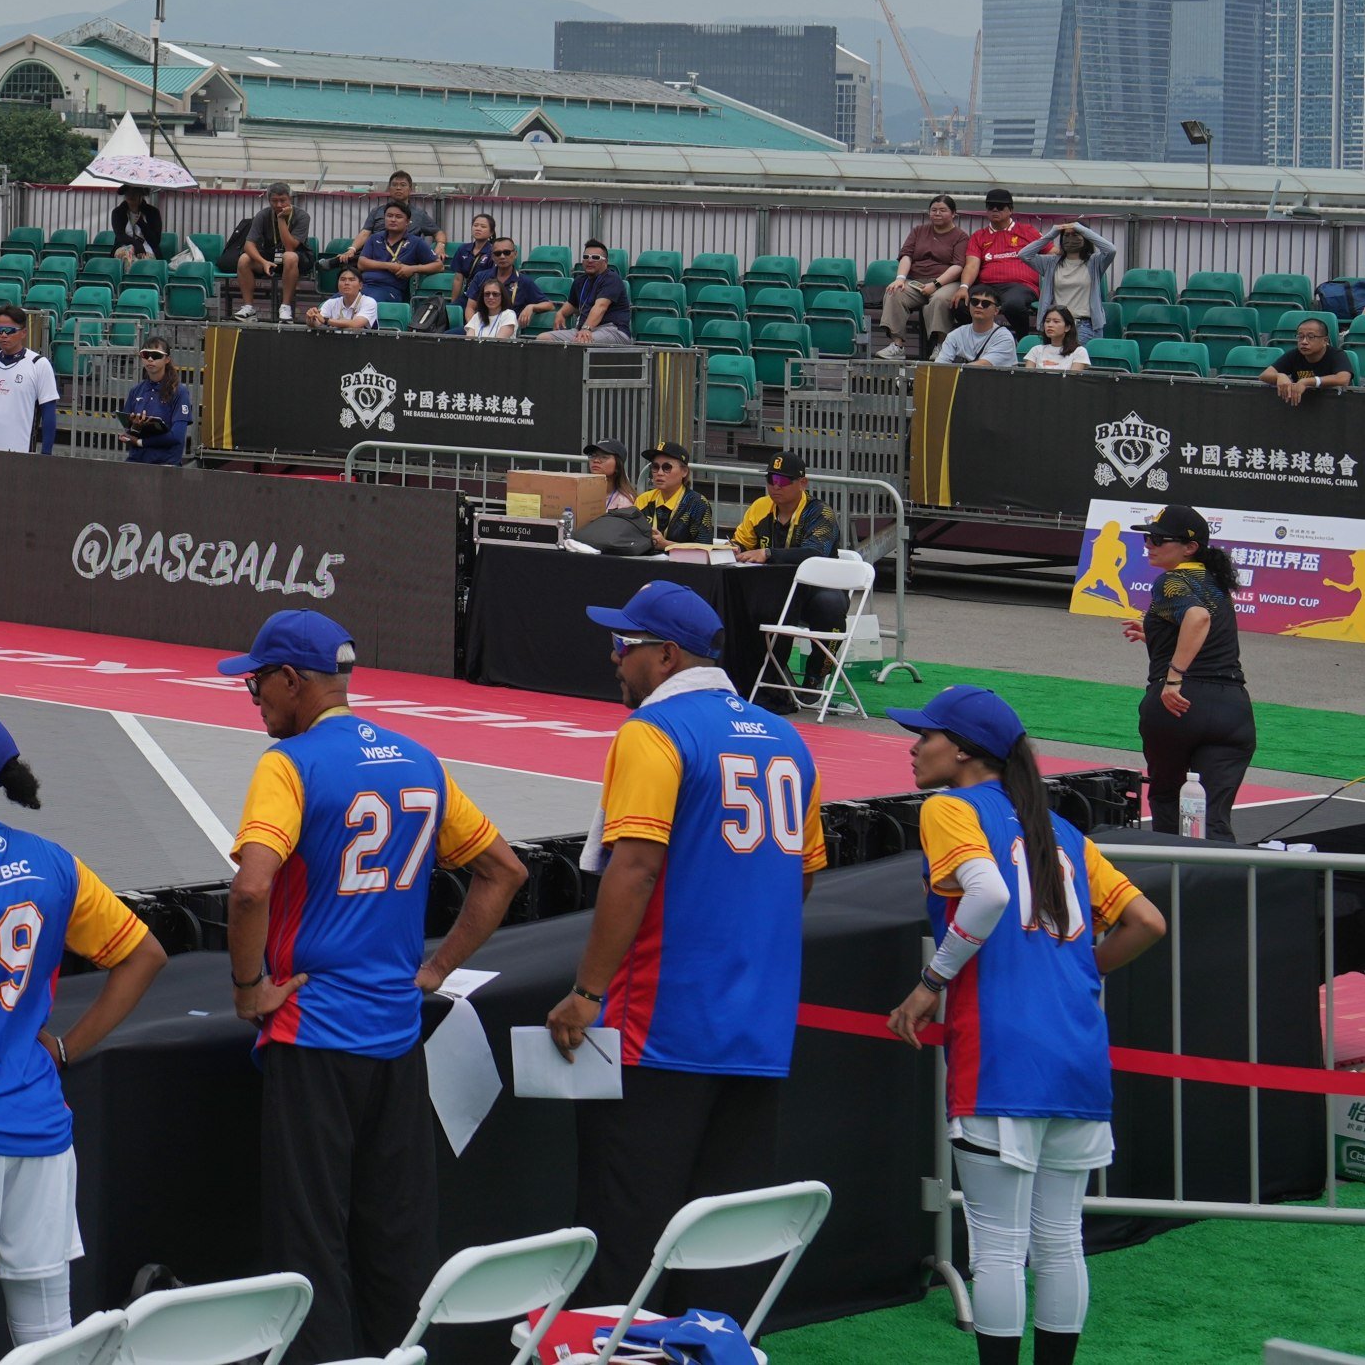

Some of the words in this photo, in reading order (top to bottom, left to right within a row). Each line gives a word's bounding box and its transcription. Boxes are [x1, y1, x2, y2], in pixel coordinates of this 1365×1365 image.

[340, 371, 397, 394] BAHKC
[403, 388, 535, 416] 中國香港棒球總會
[402, 409, 413, 417] THE
[413, 410, 439, 419] BASEBALL
[439, 412, 475, 421] ASSOCIATION
[475, 414, 482, 422] OF
[482, 415, 499, 423] HONG
[517, 417, 535, 425] CHINA
[1095, 421, 1171, 447] BAHKC
[1179, 441, 1359, 477] 中國香港棒球總會
[1179, 466, 1193, 475] THE
[1193, 467, 1229, 478] BASEBALL
[1229, 469, 1277, 481] ASSOCIATION
[1277, 473, 1287, 482] OF
[1288, 473, 1309, 484] HONG
[1310, 476, 1334, 487] KONG,
[1334, 477, 1359, 487] CHINA
[71, 522, 346, 599] @BASEBALL5
[1259, 593, 1296, 606] WORLD
[1299, 597, 1320, 608] CUP
[730, 721, 768, 736] WBSC
[360, 745, 403, 763] WBSC
[718, 753, 805, 855] 50
[336, 787, 440, 897] 27
